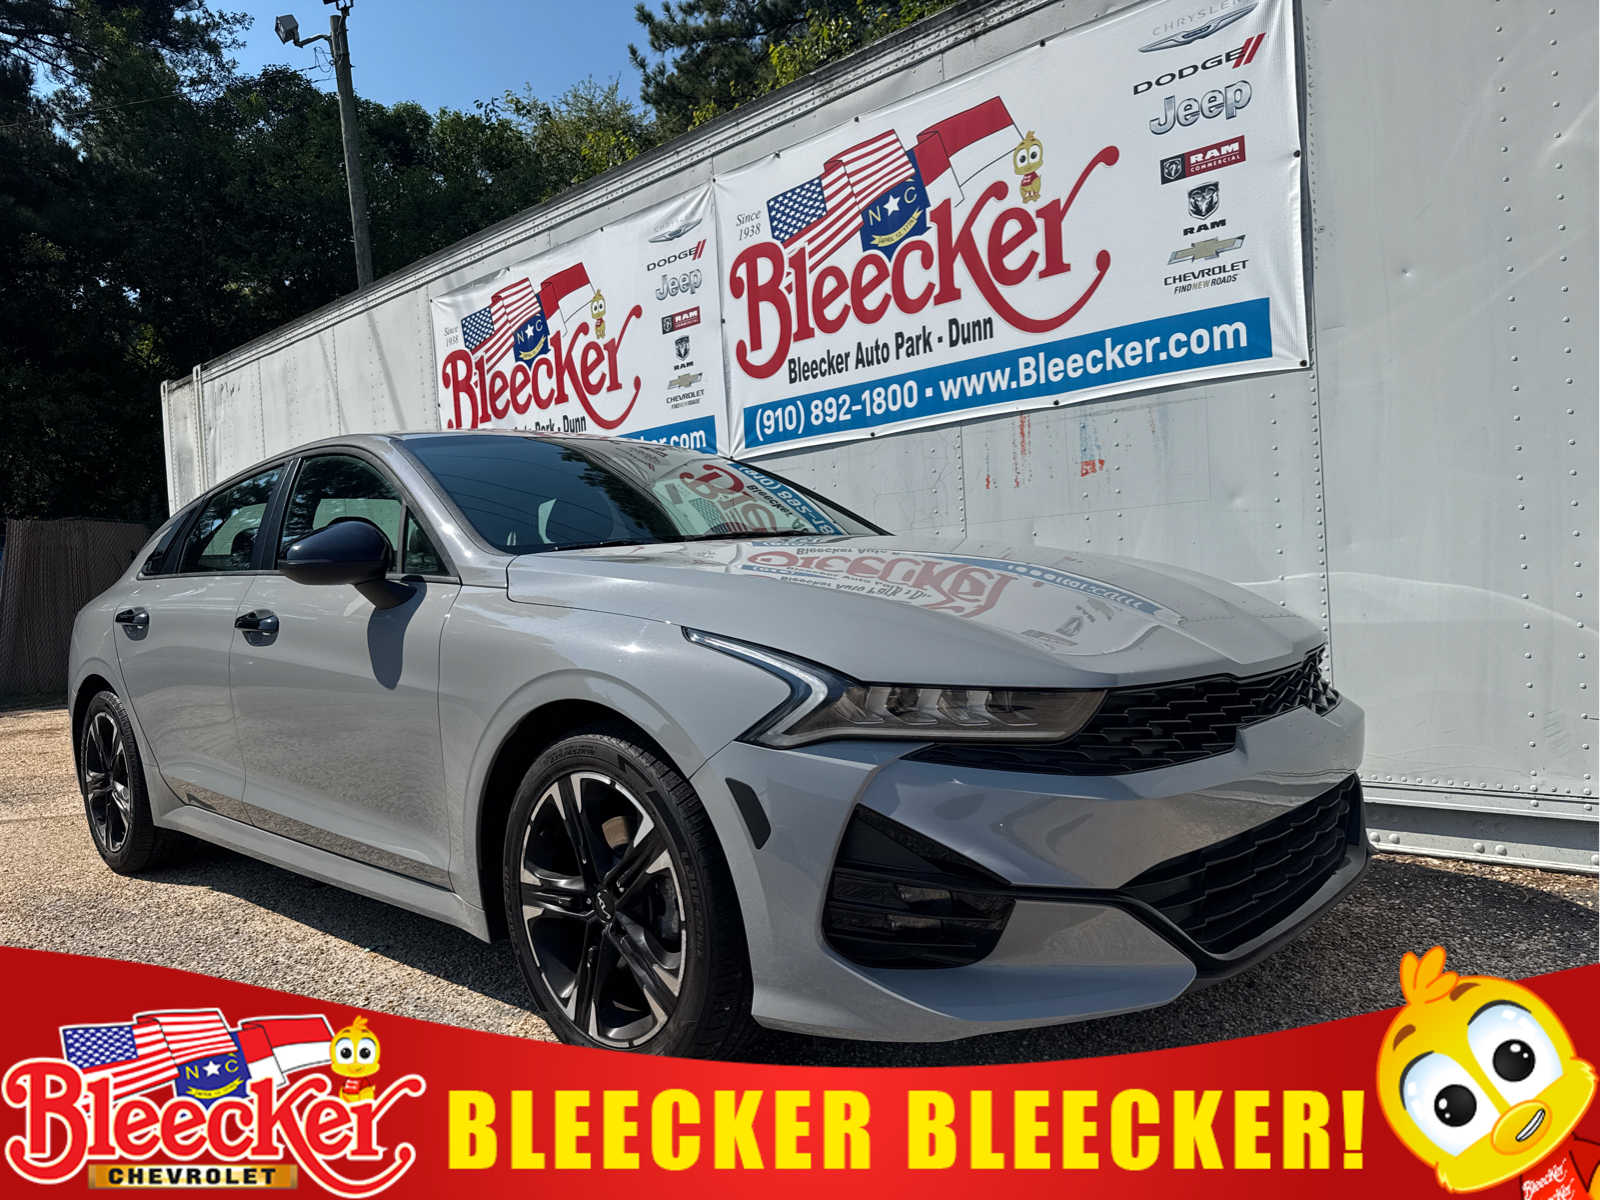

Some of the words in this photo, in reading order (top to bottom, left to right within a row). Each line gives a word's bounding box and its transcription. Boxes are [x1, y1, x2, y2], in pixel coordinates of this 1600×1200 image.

[1133, 46, 1245, 95] DODGE
[1149, 79, 1253, 135] Jeep
[1189, 141, 1240, 165] RAM
[1189, 154, 1241, 173] COMMERCIAL
[735, 209, 762, 227] Since
[868, 205, 882, 226] N
[904, 186, 918, 205] C
[738, 222, 762, 242] 1938
[1182, 218, 1227, 236] RAM
[646, 246, 699, 272] DODGE
[728, 144, 1120, 380] Bleecker
[655, 268, 703, 301] Jeep
[1163, 259, 1249, 287] CHEVROLET
[674, 310, 698, 323] RAM
[787, 351, 851, 385] Bleecker
[855, 336, 890, 370] Auto
[895, 326, 933, 357] Park
[948, 316, 995, 348] Dunn
[441, 303, 643, 430] Bleecker
[673, 360, 694, 371] RAM
[754, 400, 805, 442] (910)
[810, 380, 918, 426] 892-1800
[939, 318, 1248, 402] www.Bleecker.com
[562, 414, 587, 433] Dunn
